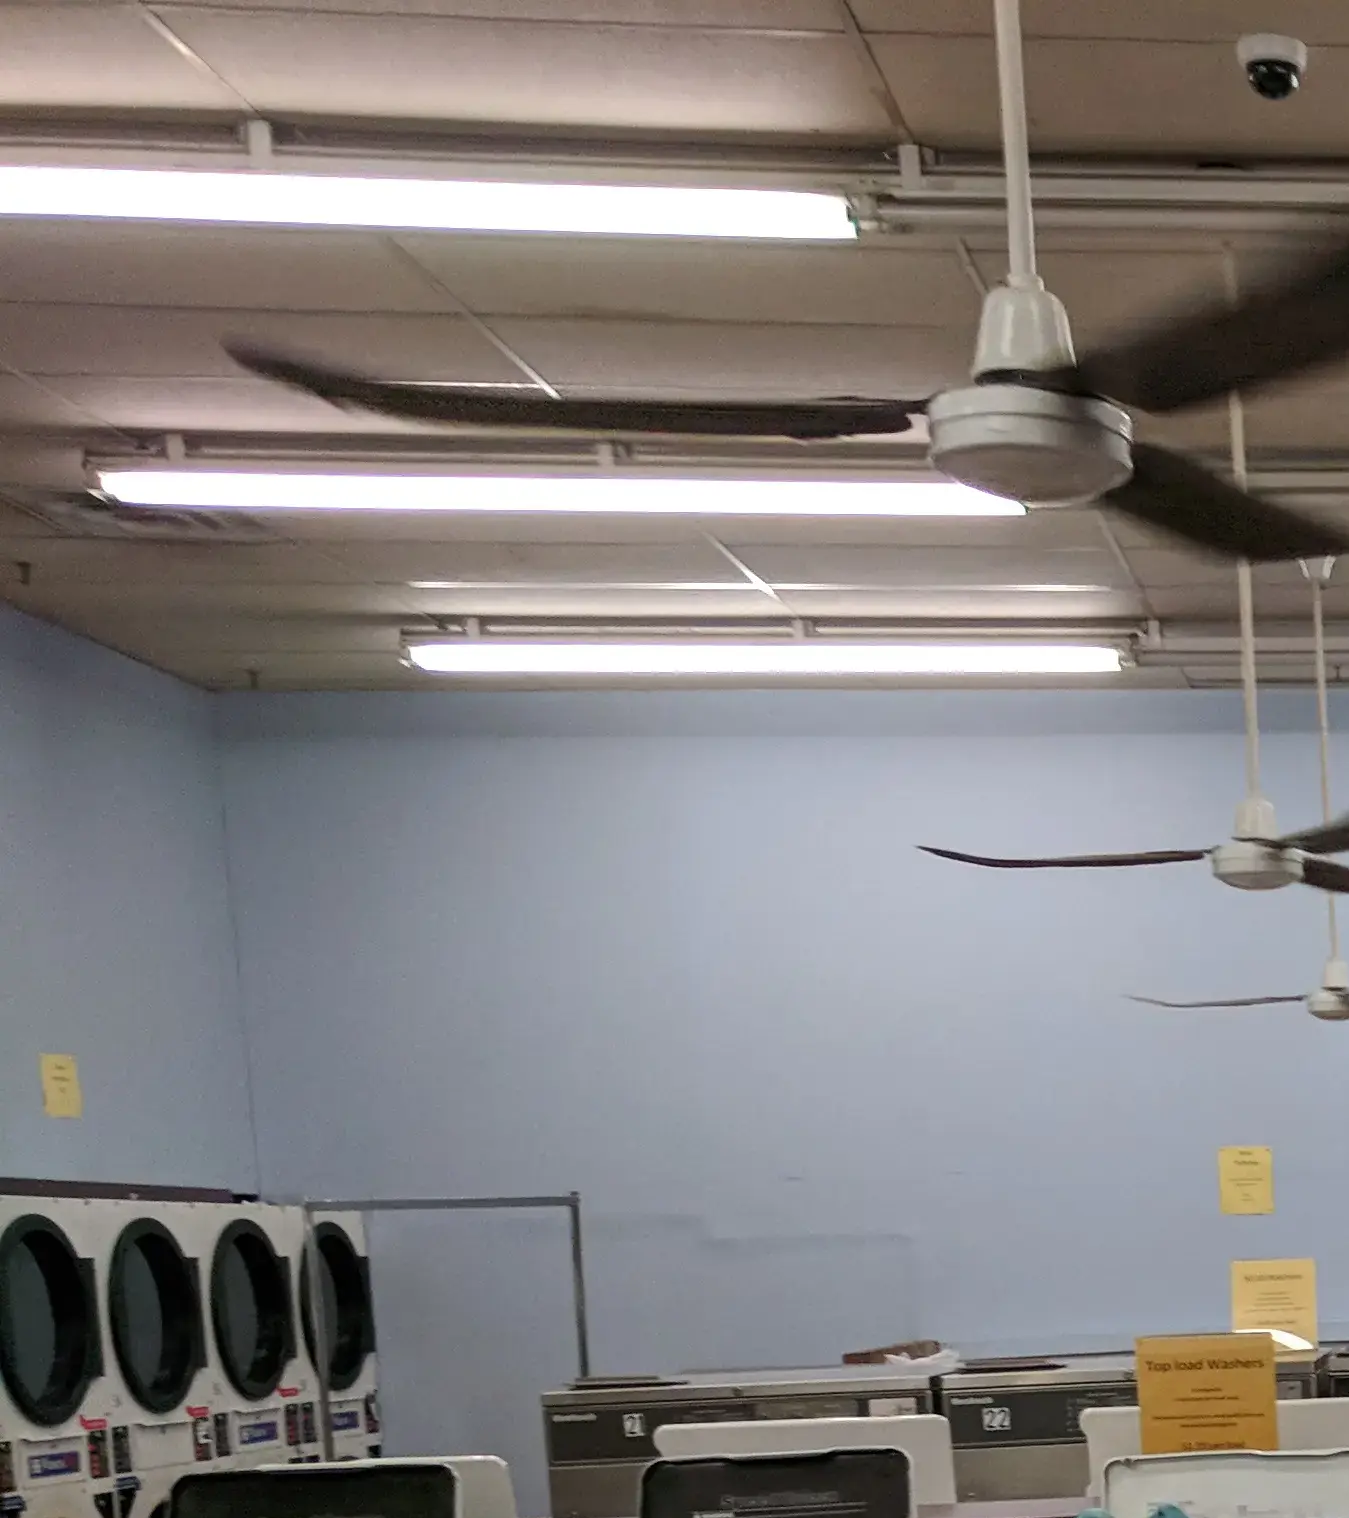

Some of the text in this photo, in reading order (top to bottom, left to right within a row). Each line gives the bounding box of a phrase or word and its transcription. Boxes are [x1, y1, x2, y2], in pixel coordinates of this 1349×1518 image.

[1146, 1355, 1265, 1374] Top load Washers
[983, 1407, 1011, 1430] 22
